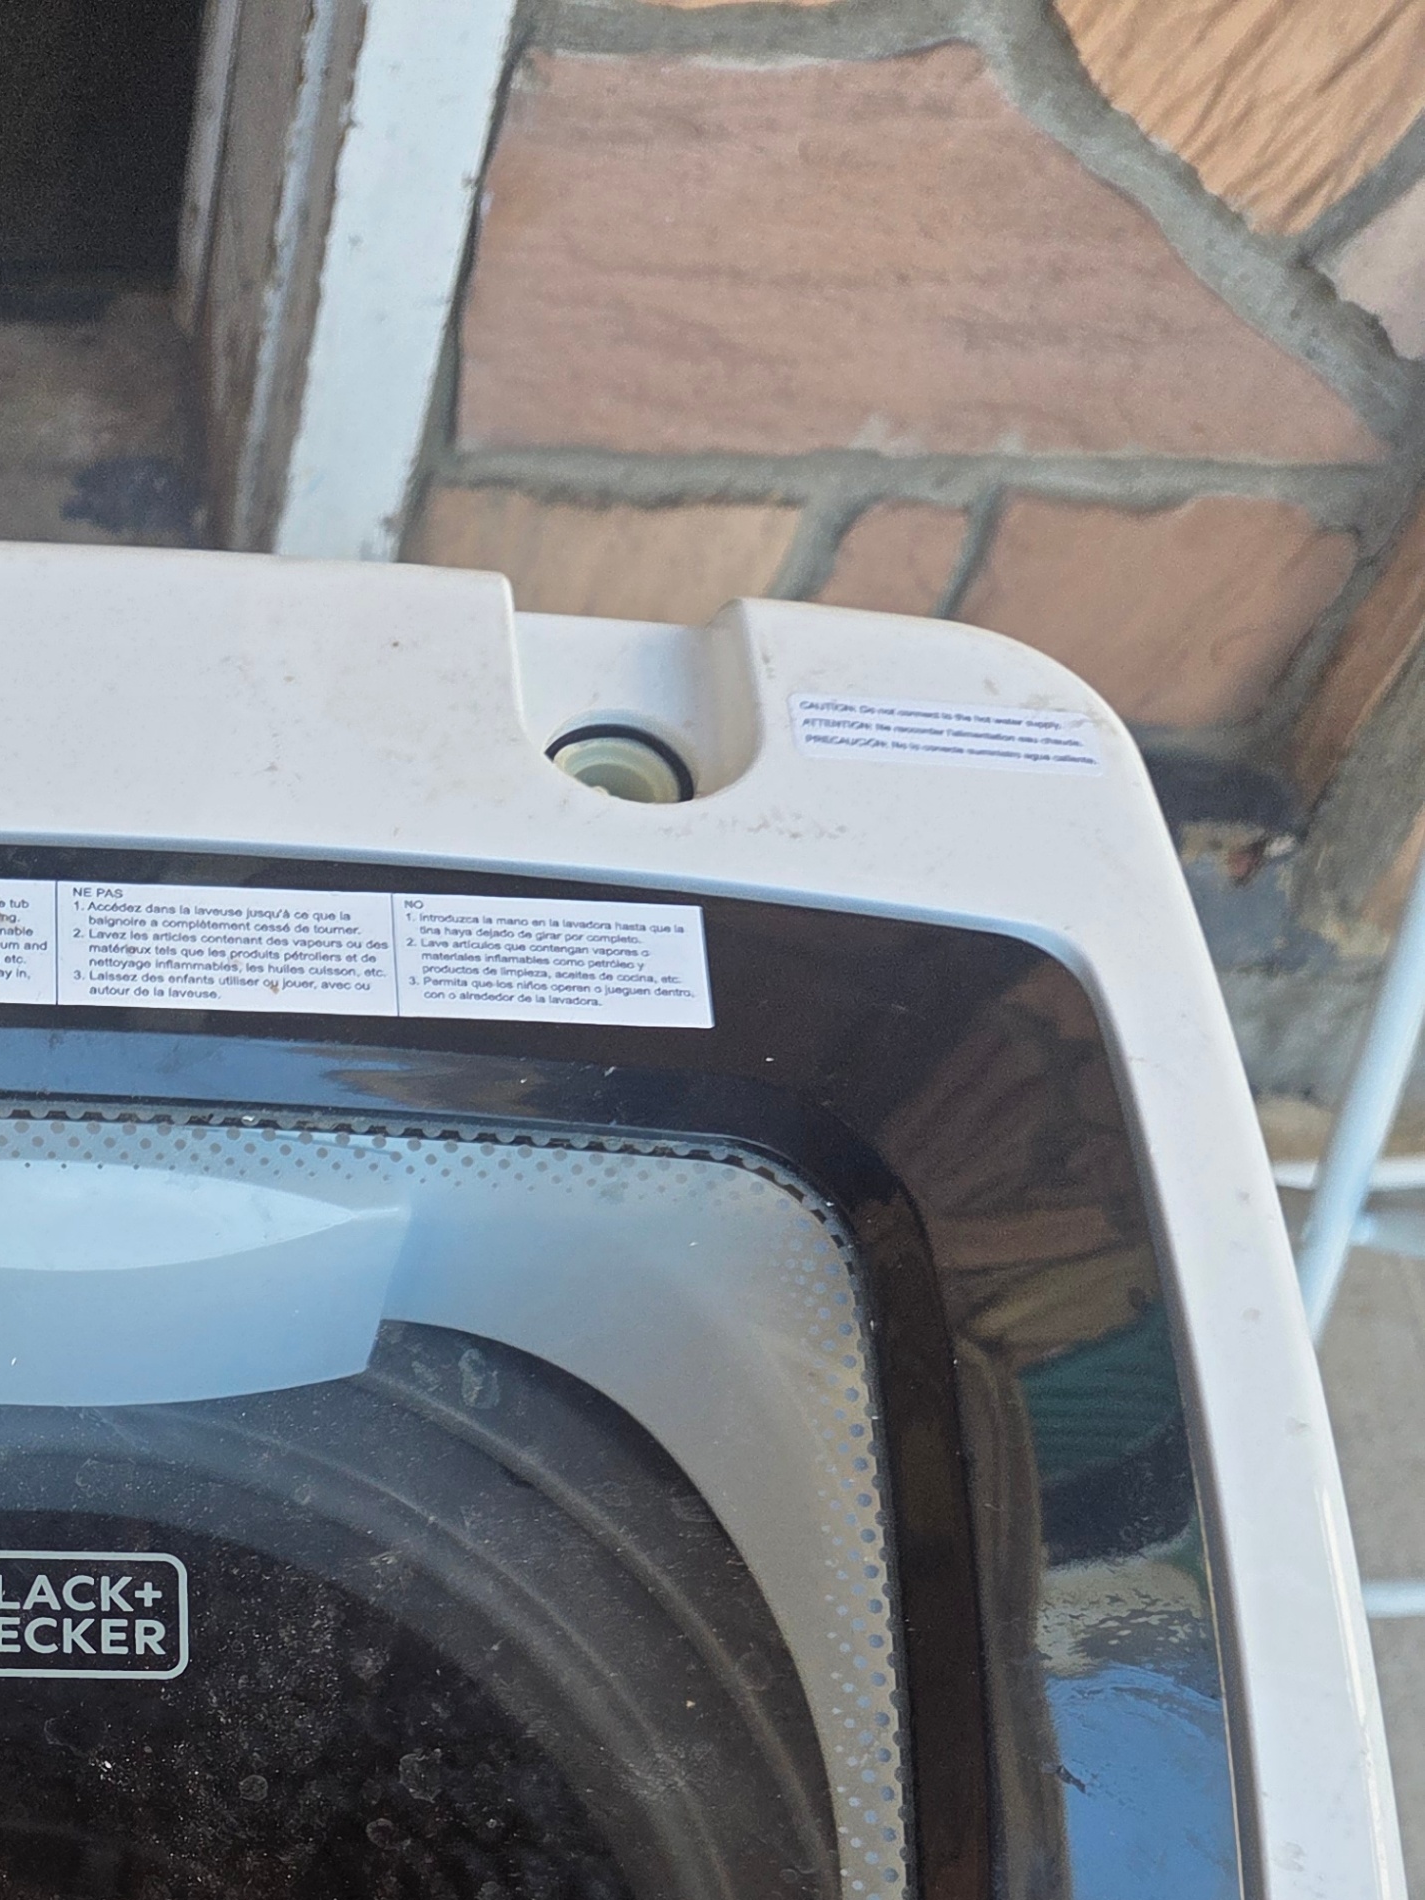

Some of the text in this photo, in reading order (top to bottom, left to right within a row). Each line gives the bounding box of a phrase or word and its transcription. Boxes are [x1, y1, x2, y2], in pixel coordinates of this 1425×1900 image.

[73, 888, 123, 898] NE PAS
[9, 899, 30, 909] tub
[404, 900, 424, 910] NO
[24, 940, 48, 951] and
[4, 955, 27, 965] etc.
